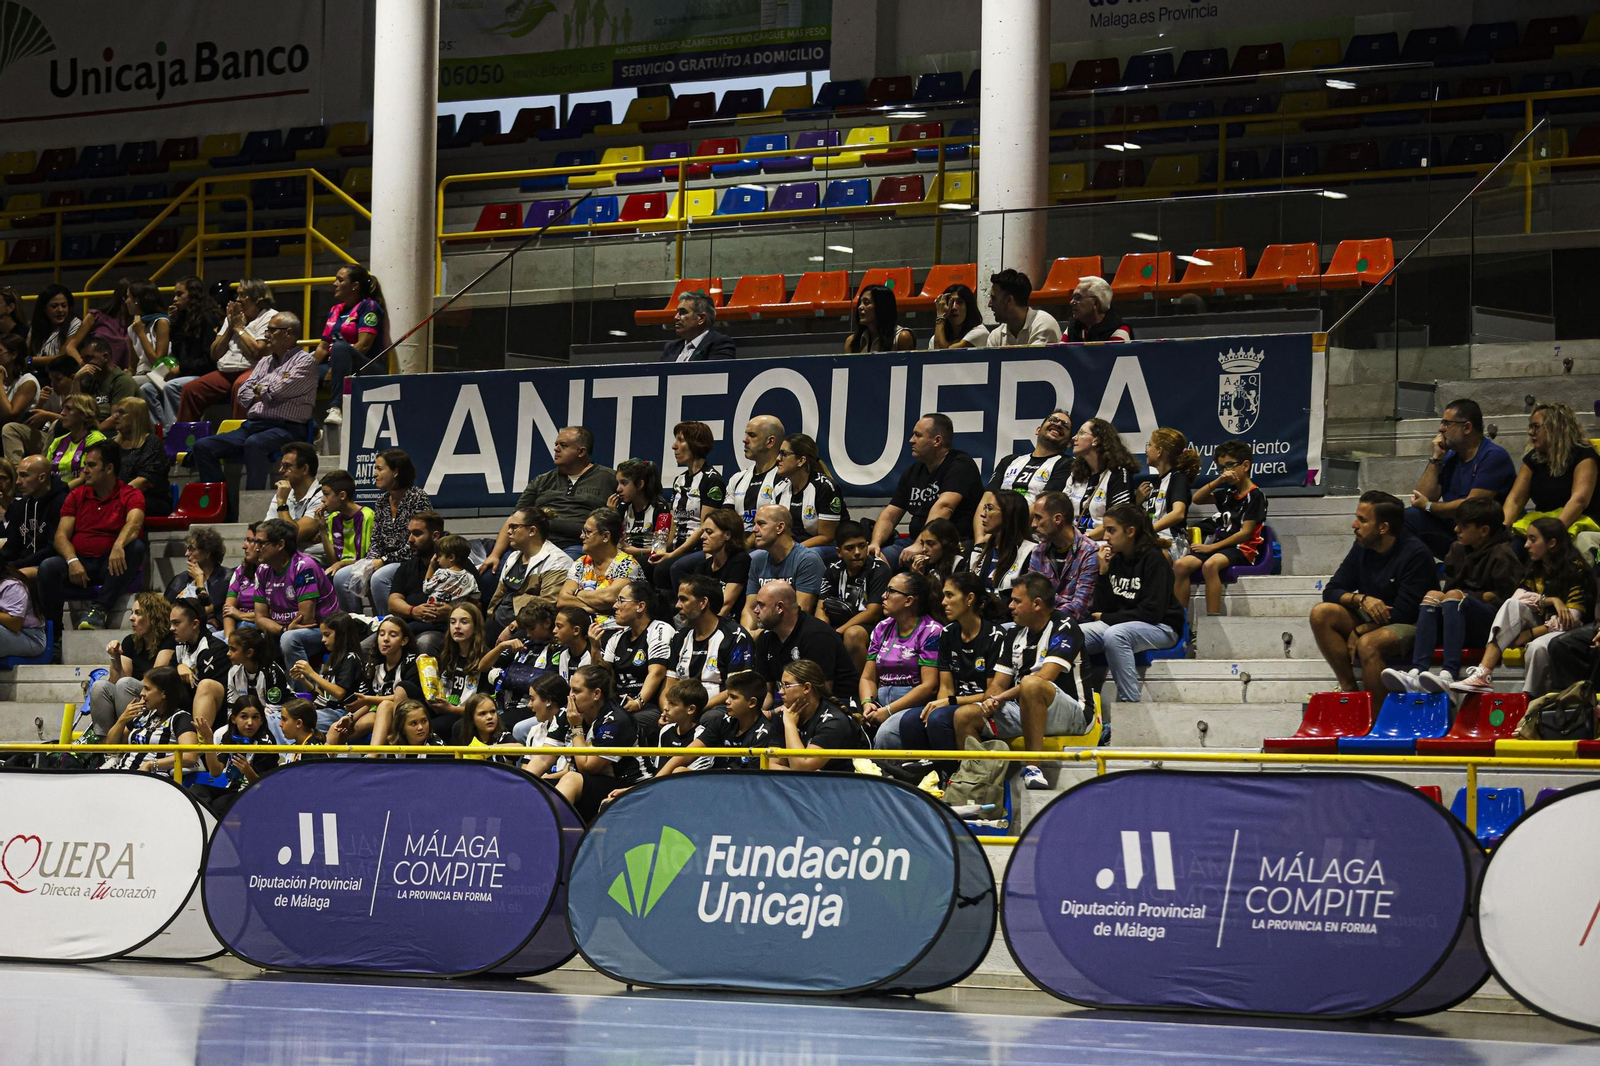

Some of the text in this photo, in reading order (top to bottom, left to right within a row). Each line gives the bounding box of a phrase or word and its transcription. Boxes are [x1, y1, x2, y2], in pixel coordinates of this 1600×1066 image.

[1158, 4, 1218, 22] Provincia
[615, 44, 647, 55] AHORRE
[649, 43, 659, 52] EN
[660, 35, 734, 52] DESPLAZAMIENTOS
[735, 35, 741, 43] Y
[741, 34, 753, 43] NO
[805, 27, 827, 37] PESO
[50, 41, 310, 100] Unicaja Banco
[621, 59, 675, 78] SERVICIO
[743, 56, 751, 66] A
[754, 47, 824, 65] DOMICILIO
[1231, 664, 1239, 675] 3
[453, 676, 465, 690] 29
[404, 829, 499, 858] MÁLAGA
[705, 835, 911, 882] Fundación
[1259, 851, 1385, 885] MÁLAGA
[249, 875, 362, 891] Diputación Provincial
[393, 861, 506, 888] COMPITE
[40, 880, 156, 900] Directa a tu corazón
[397, 890, 492, 902] LA PROVINCIA EN FORMA
[274, 894, 330, 911] de Málaga
[699, 881, 843, 940] Unicaja
[1060, 900, 1207, 919] Diputación Provincial
[1246, 886, 1394, 918] COMPITE
[1093, 921, 1166, 942] de Málaga
[1252, 919, 1377, 934] LA PROVINCIA EN FORMA
